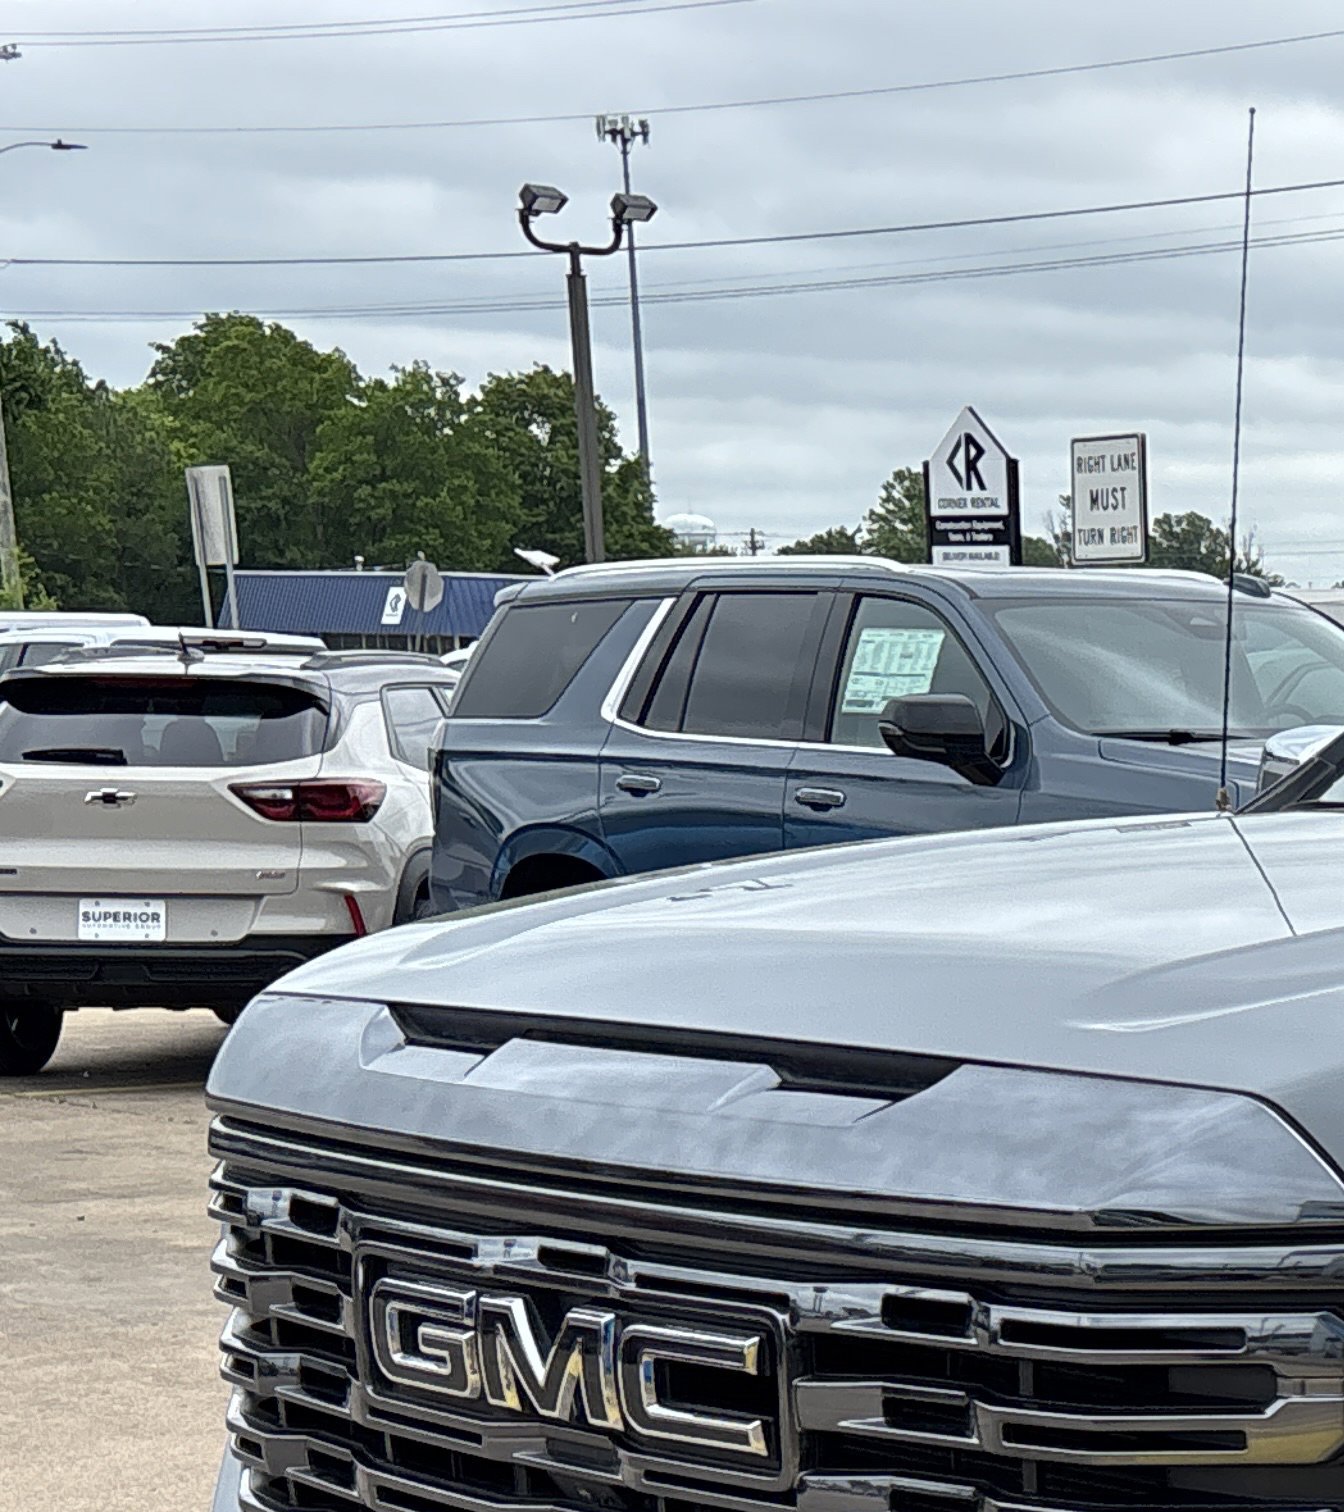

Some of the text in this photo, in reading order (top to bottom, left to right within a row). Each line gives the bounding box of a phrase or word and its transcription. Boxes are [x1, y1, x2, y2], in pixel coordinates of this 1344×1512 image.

[1076, 452, 1137, 474] RIGHT LANE
[1089, 486, 1127, 511] MUST
[1077, 525, 1138, 546] TURN RIGHT
[81, 910, 161, 923] SUPERIOR
[369, 1277, 769, 1457] GMC
